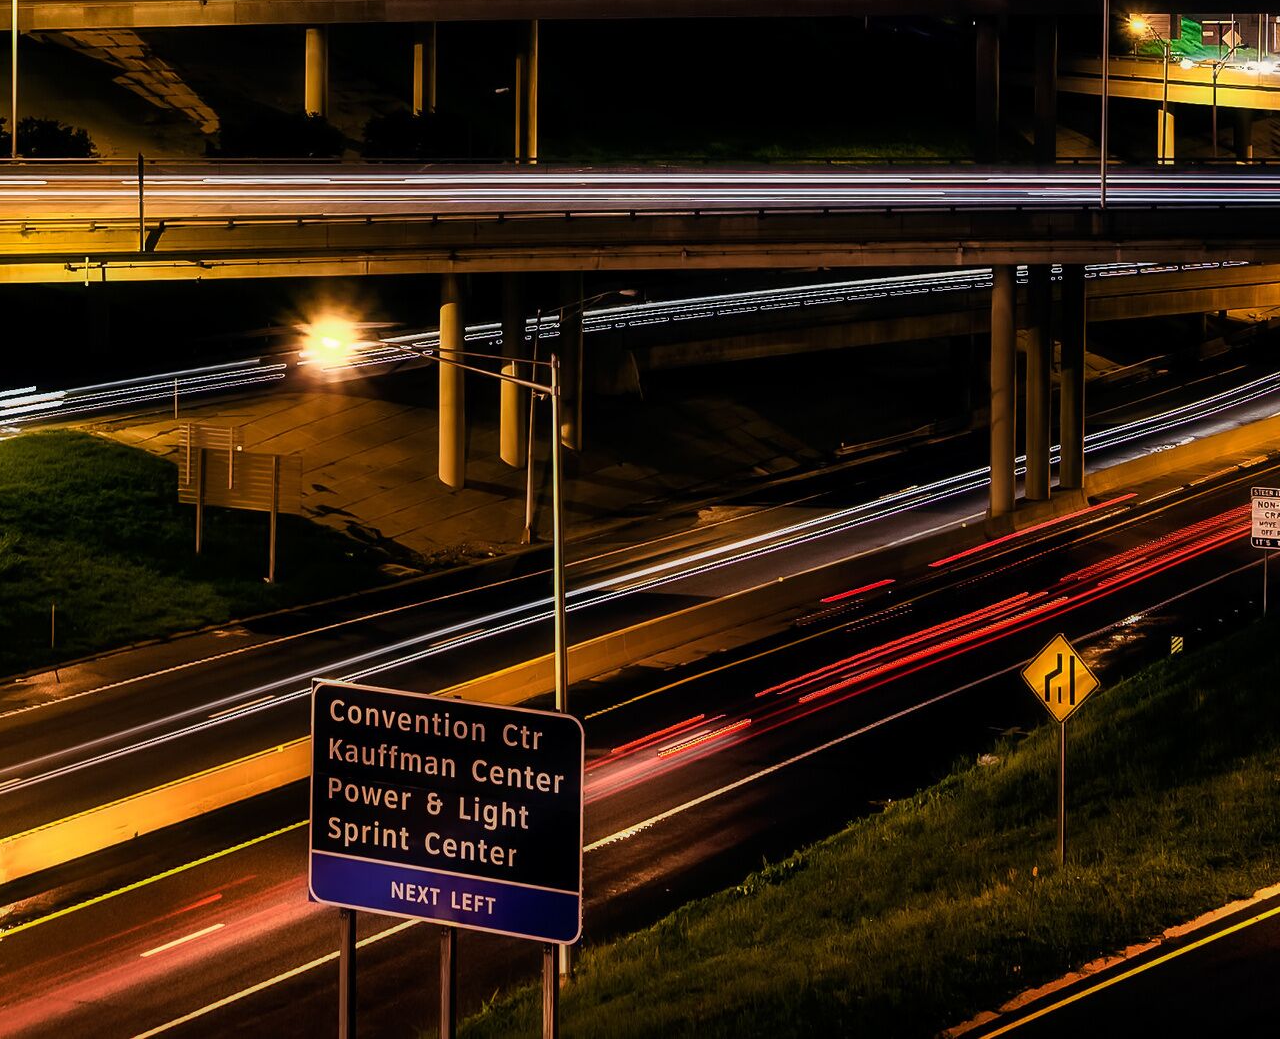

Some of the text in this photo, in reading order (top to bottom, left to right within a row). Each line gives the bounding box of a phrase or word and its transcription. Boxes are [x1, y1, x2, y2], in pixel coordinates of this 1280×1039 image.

[329, 699, 543, 750] Convention Ctr
[328, 737, 564, 794] Kauffman Center
[327, 777, 529, 831] Power & Light
[327, 816, 517, 867] Sprint Center
[391, 881, 496, 915] NEXT LEFT
